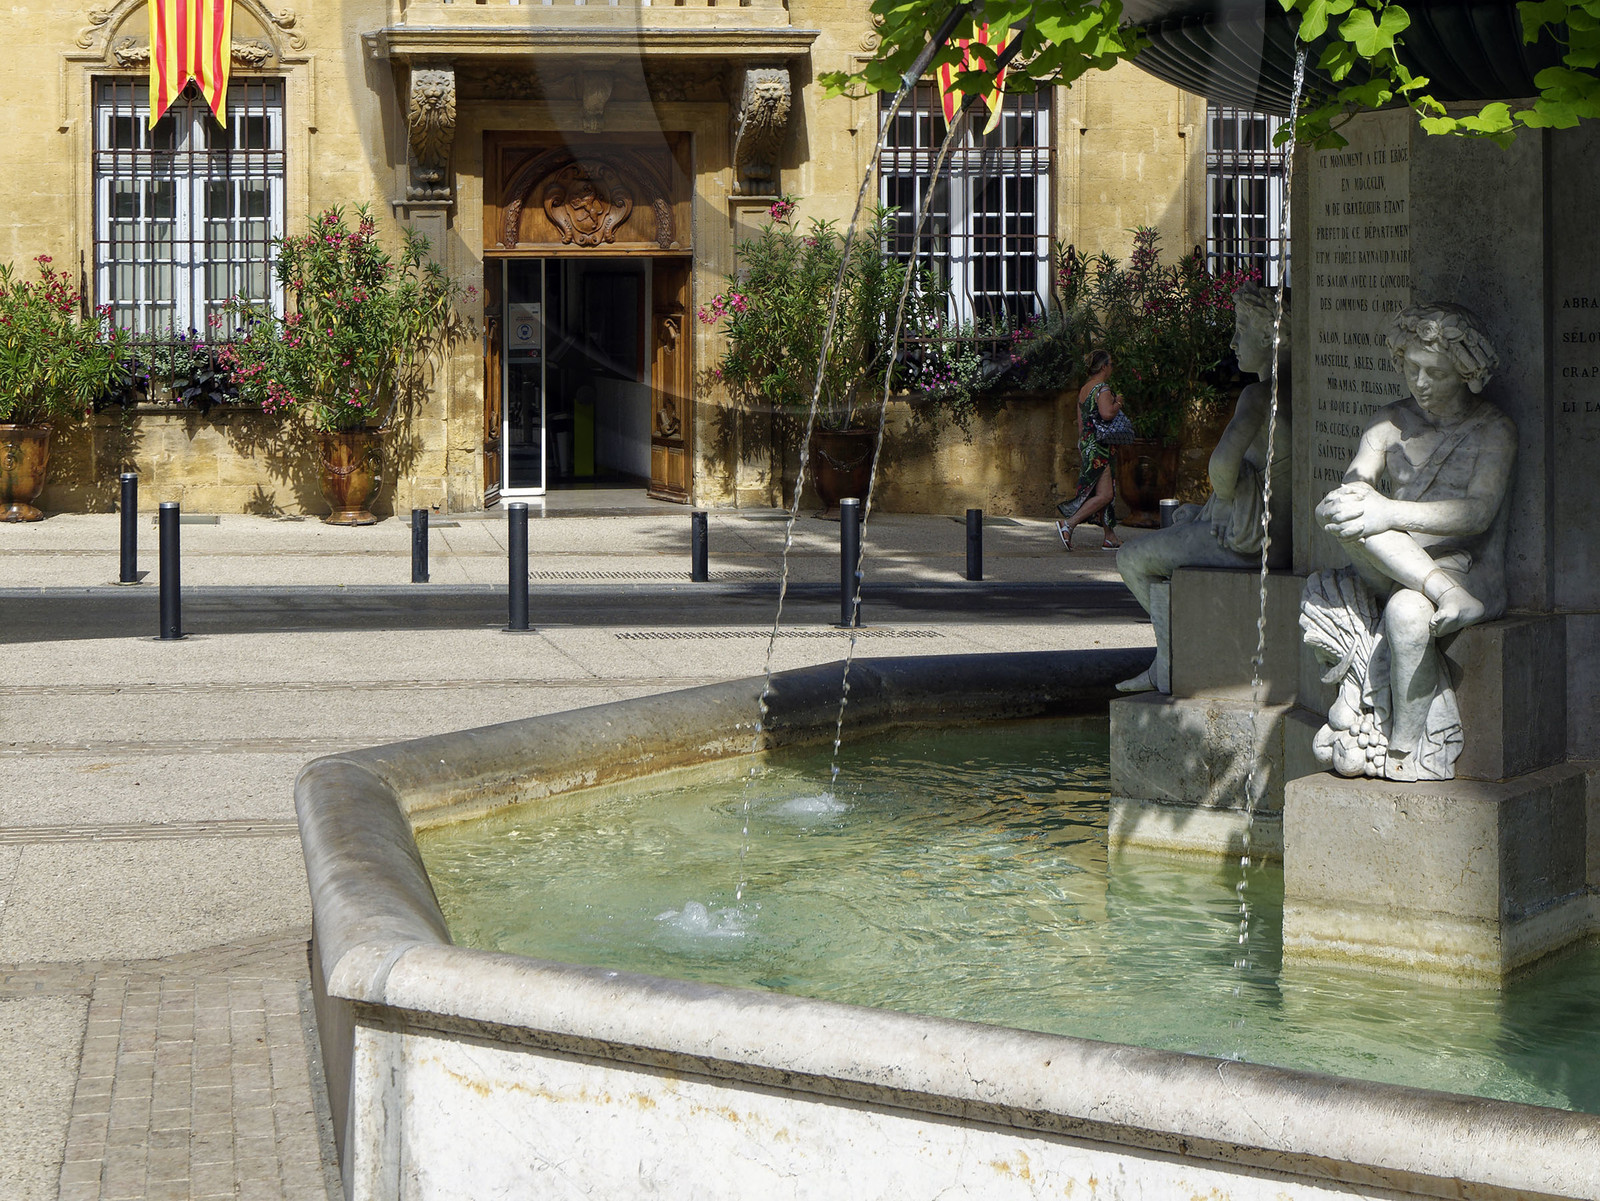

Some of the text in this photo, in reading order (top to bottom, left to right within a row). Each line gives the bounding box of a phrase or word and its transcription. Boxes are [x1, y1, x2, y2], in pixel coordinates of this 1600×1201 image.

[1330, 152, 1363, 168] MONUMENT
[1341, 178, 1350, 192] EN
[1332, 202, 1340, 216] DE
[1351, 227, 1360, 240] CE
[1316, 274, 1324, 288] DE
[1327, 274, 1348, 288] SALON
[1350, 274, 1367, 288] AVEC
[1369, 274, 1377, 288] LE
[1320, 297, 1332, 311] DES
[1335, 298, 1368, 312] COMMUNES
[1318, 398, 1327, 411] LA
[1562, 401, 1576, 413] LI
[1317, 443, 1346, 461] SAINTES
[1313, 467, 1322, 480] LA
